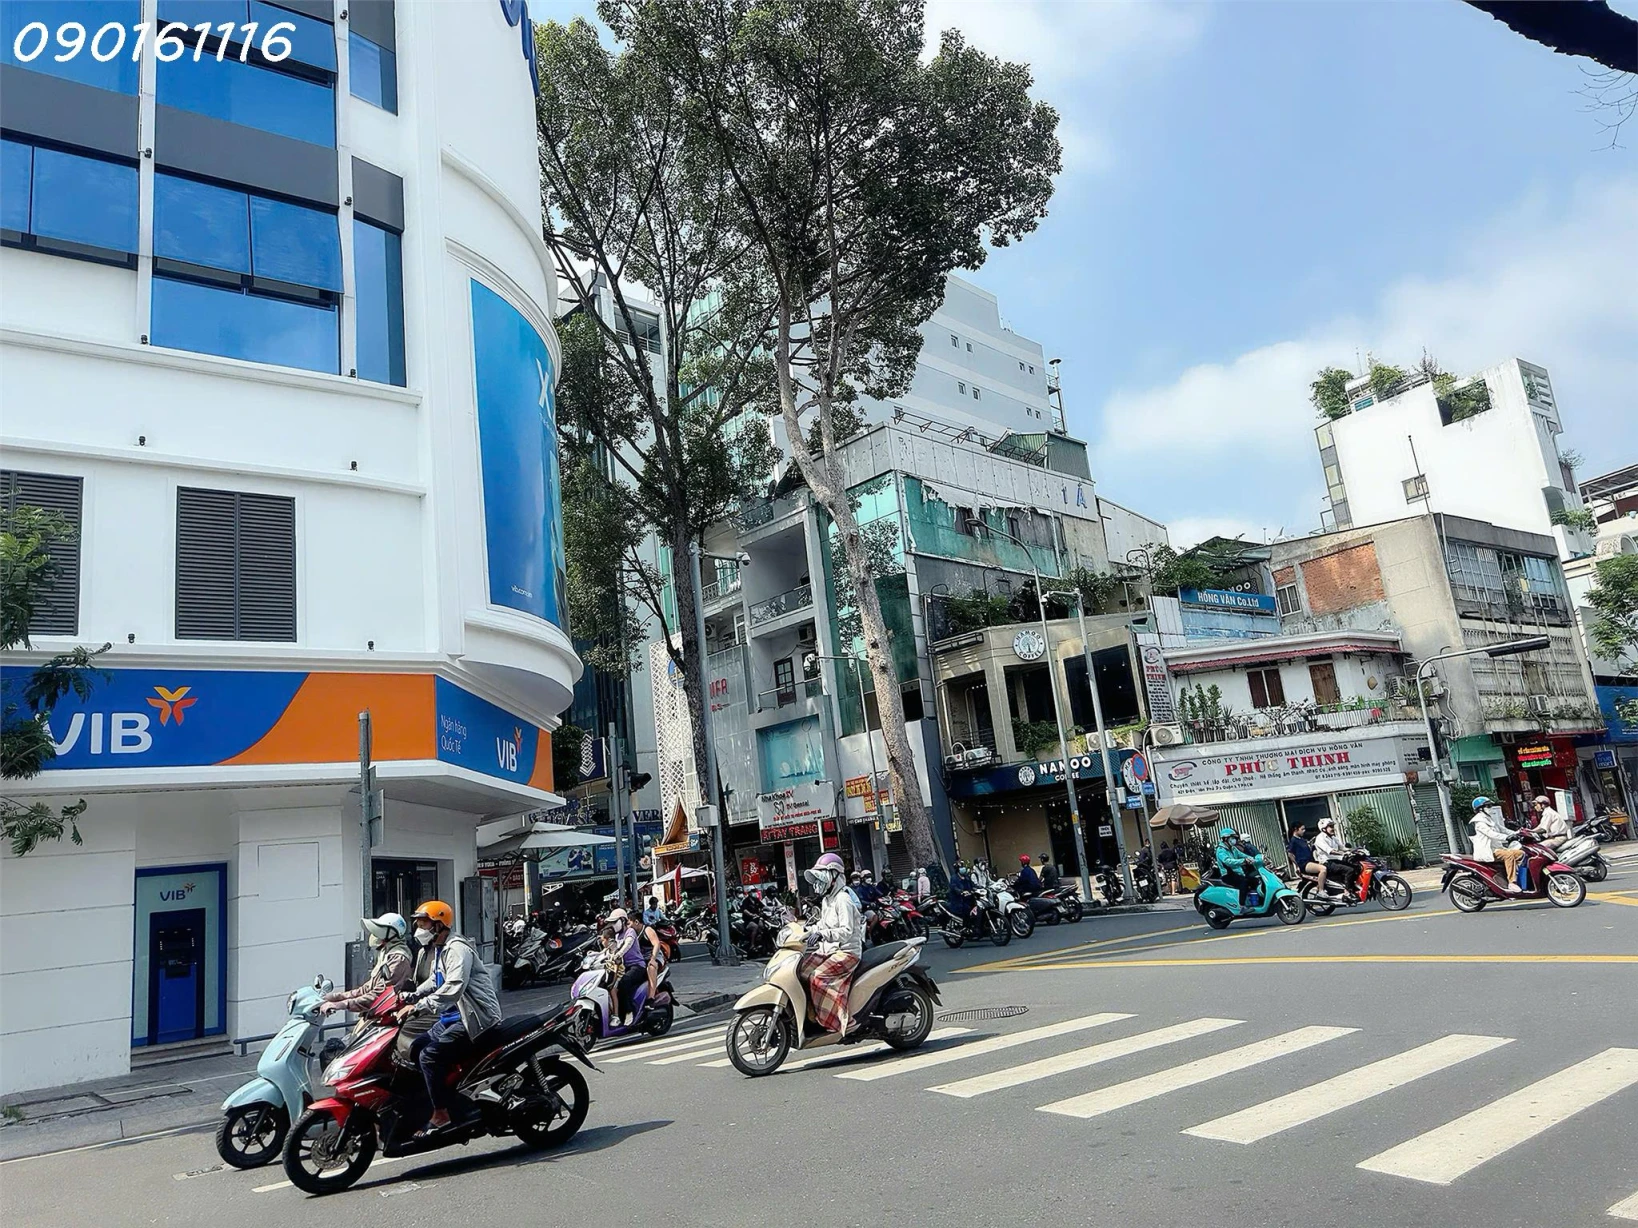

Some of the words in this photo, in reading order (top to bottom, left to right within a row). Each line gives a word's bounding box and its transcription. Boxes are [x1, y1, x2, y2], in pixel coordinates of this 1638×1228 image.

[1220, 593, 1236, 605] VÂN
[1238, 597, 1259, 607] Co.Ltd
[34, 711, 152, 756] VIB
[441, 714, 454, 733] Ngân
[455, 719, 467, 740] hàng
[441, 735, 455, 753] Quốc
[455, 739, 461, 754] Tế
[496, 736, 517, 772] VIB
[1202, 758, 1222, 766] CÔNG
[1225, 759, 1280, 776] PHÚC
[1286, 751, 1350, 770] THỊNH
[160, 889, 186, 901] VIB
